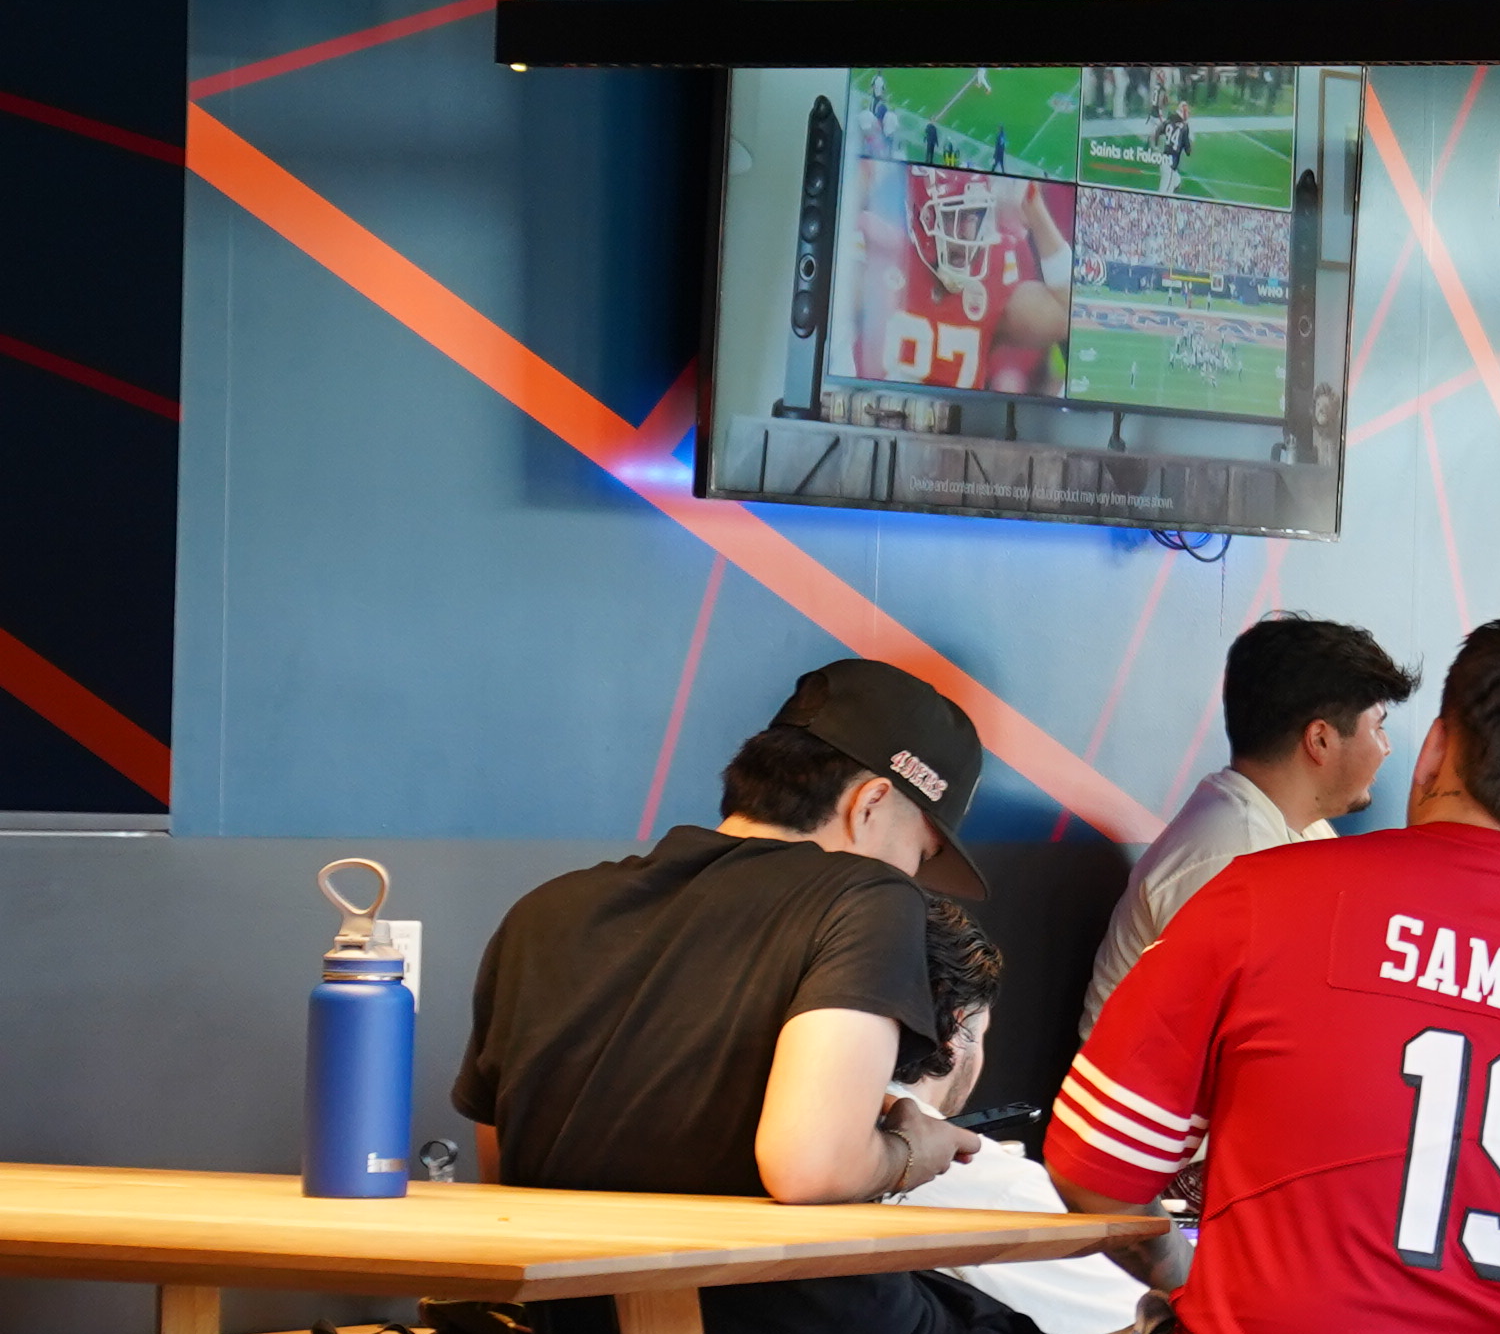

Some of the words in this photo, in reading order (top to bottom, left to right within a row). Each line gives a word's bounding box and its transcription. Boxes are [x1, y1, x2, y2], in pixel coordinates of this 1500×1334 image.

[1090, 140, 1121, 160] Saints
[1122, 146, 1134, 160] at
[1136, 149, 1174, 167] Falcons
[1257, 283, 1283, 299] WHO
